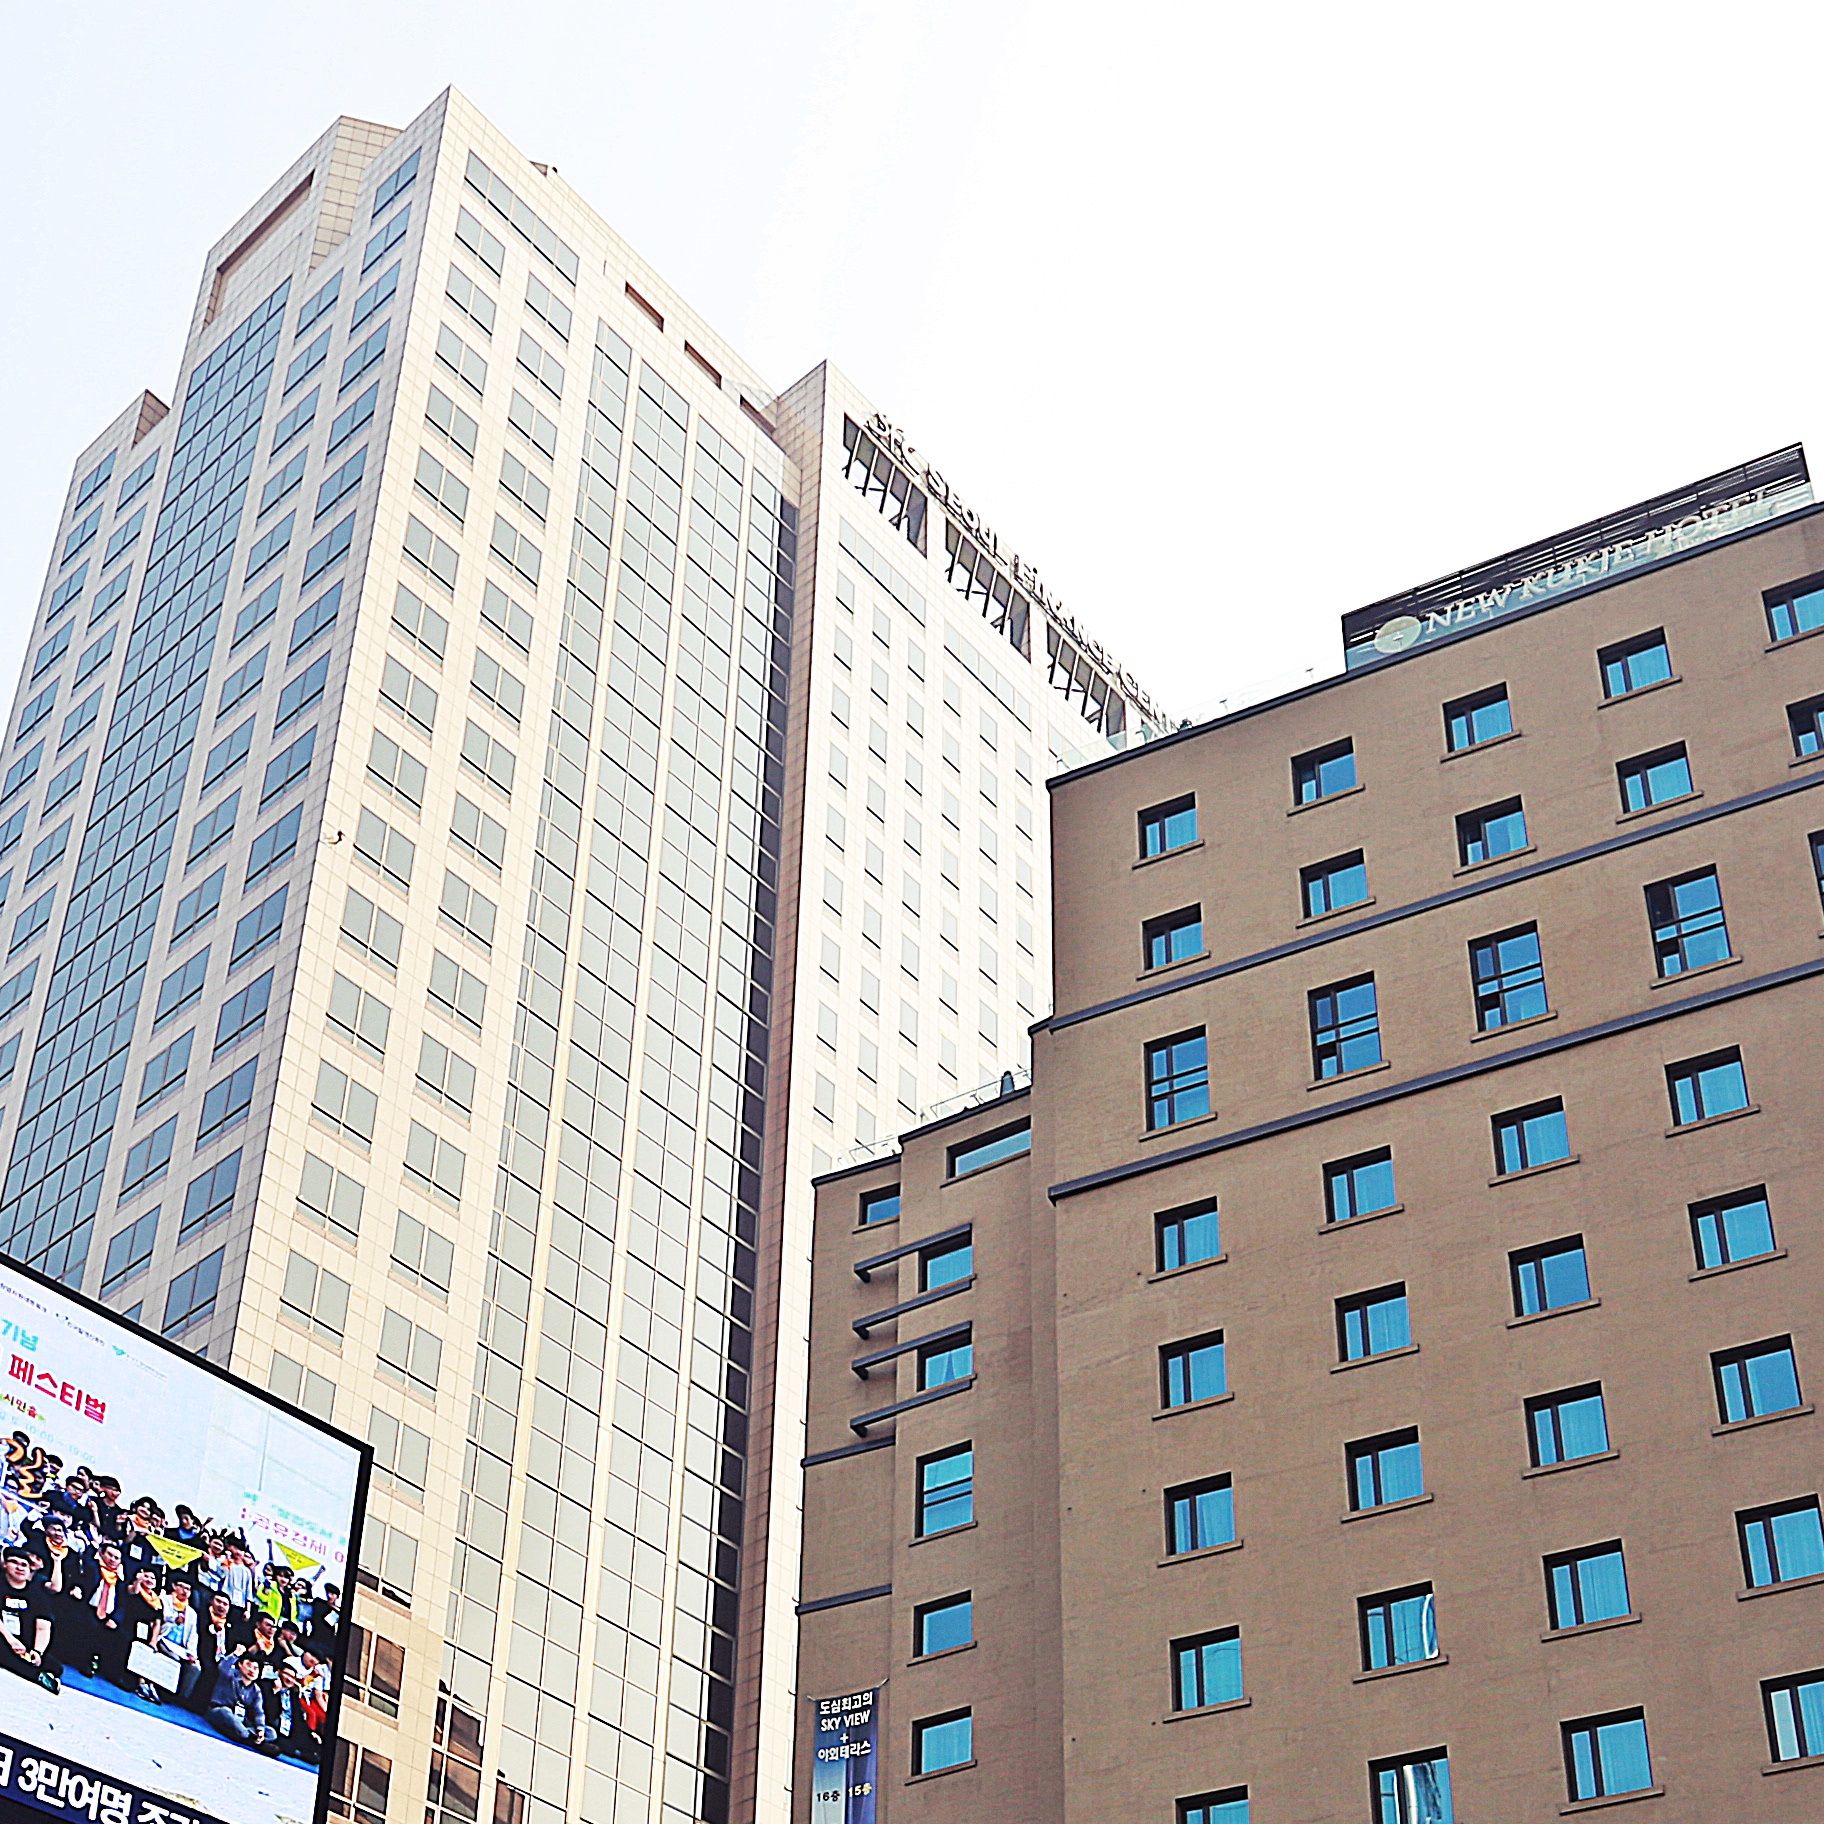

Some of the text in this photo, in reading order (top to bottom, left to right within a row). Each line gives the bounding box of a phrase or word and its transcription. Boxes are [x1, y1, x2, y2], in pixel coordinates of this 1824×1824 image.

[1425, 583, 1513, 635] NEW
[7, 1350, 108, 1424] 페스티벌
[820, 1709, 871, 1732] SKY VIEW
[817, 1740, 872, 1762] 야외테라스
